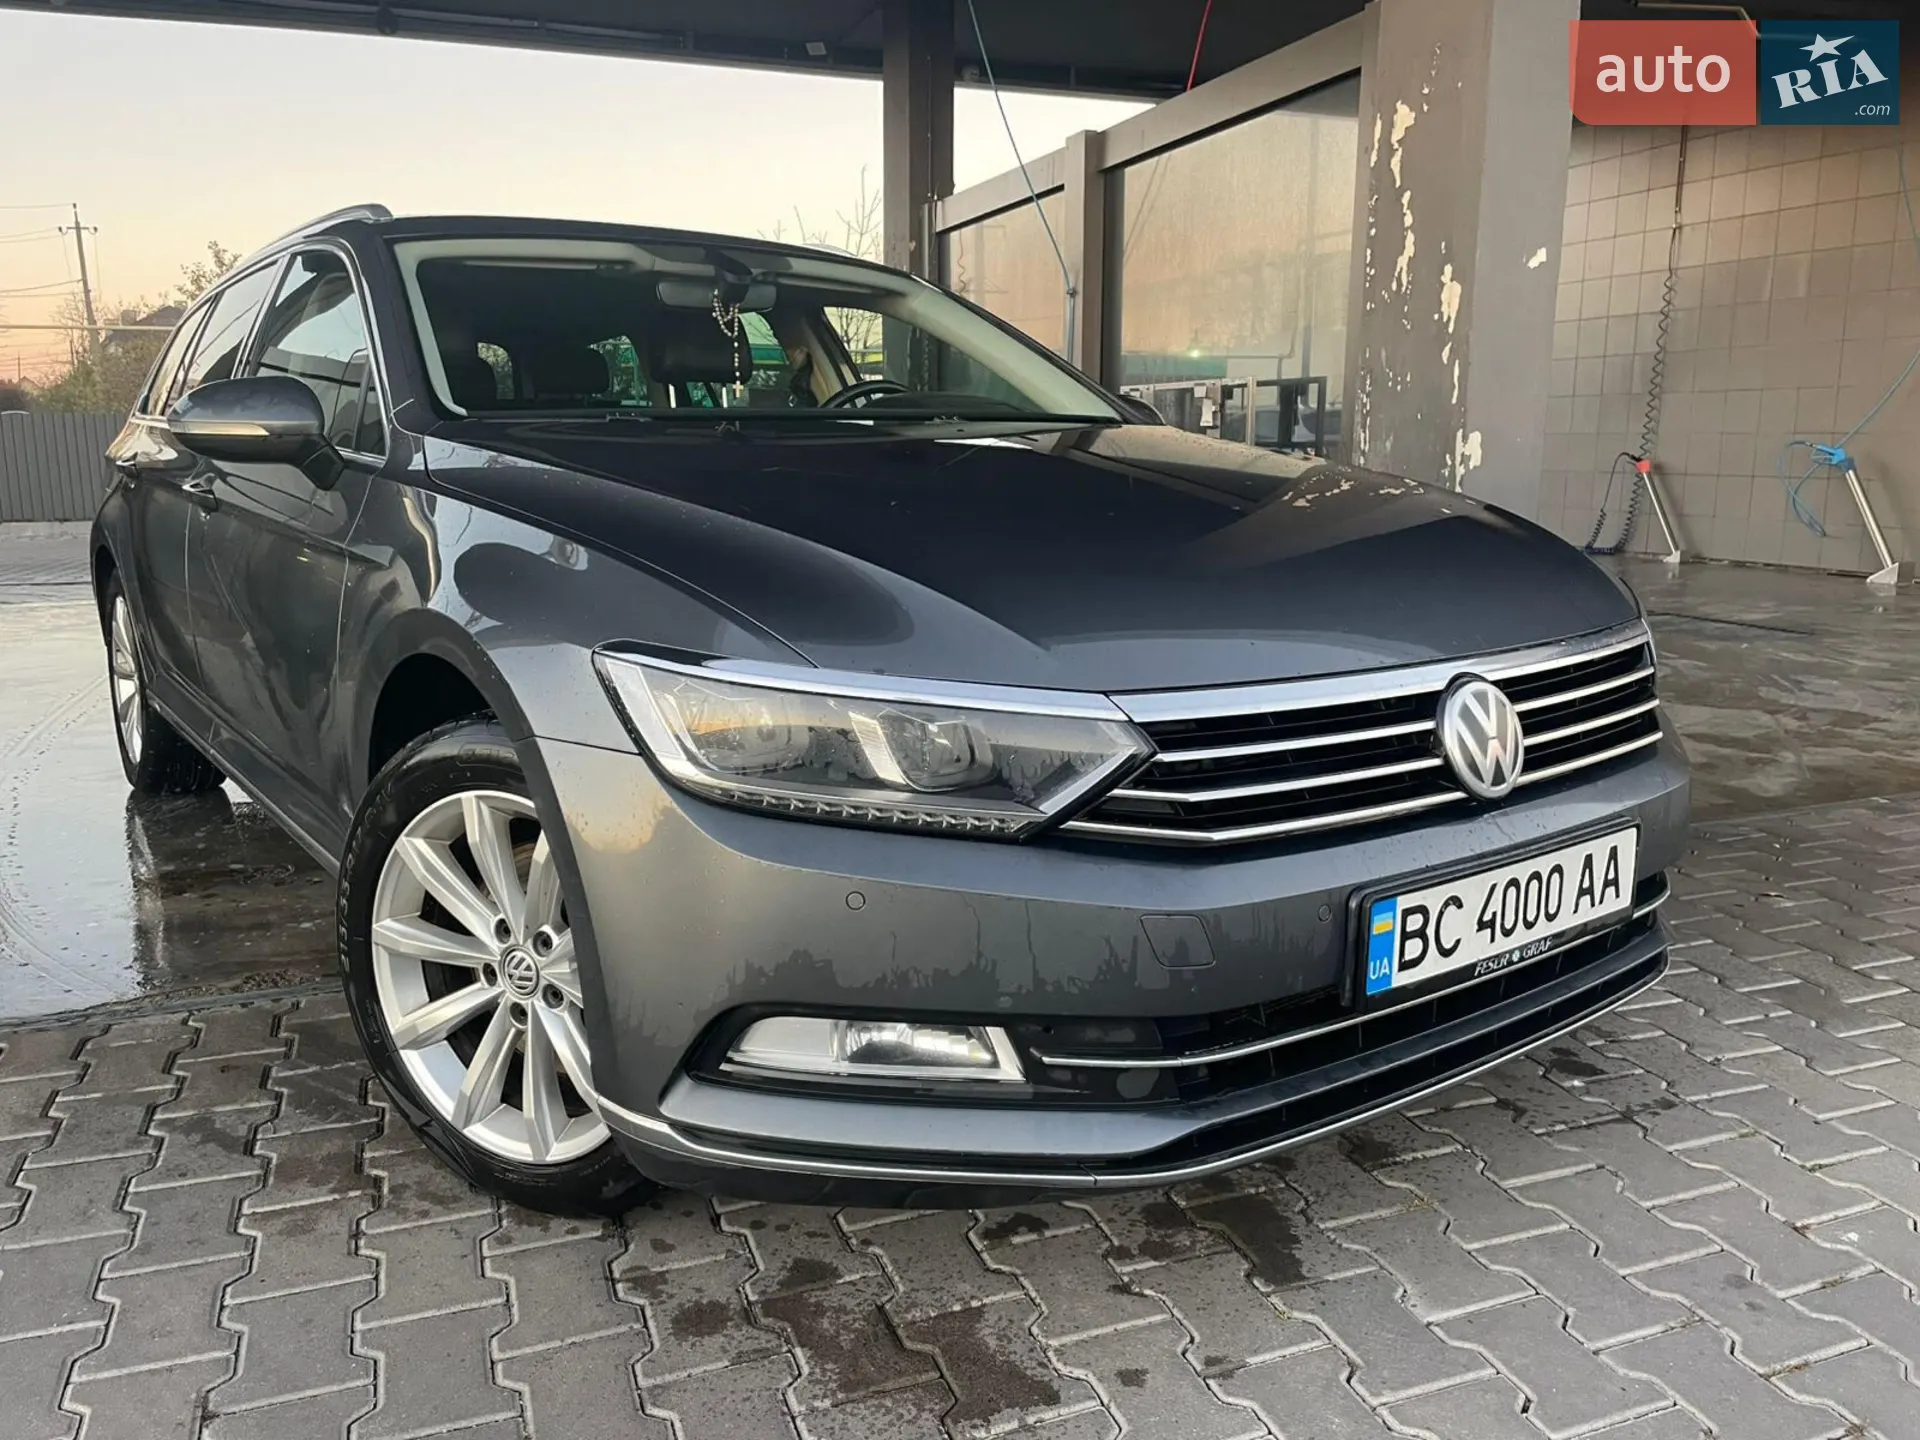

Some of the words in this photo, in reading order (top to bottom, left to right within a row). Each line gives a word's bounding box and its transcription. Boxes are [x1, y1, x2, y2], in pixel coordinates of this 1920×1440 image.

[1398, 895, 1464, 972] BC
[1476, 864, 1564, 943] 4000
[1573, 846, 1620, 914] AA
[1370, 957, 1390, 980] UA
